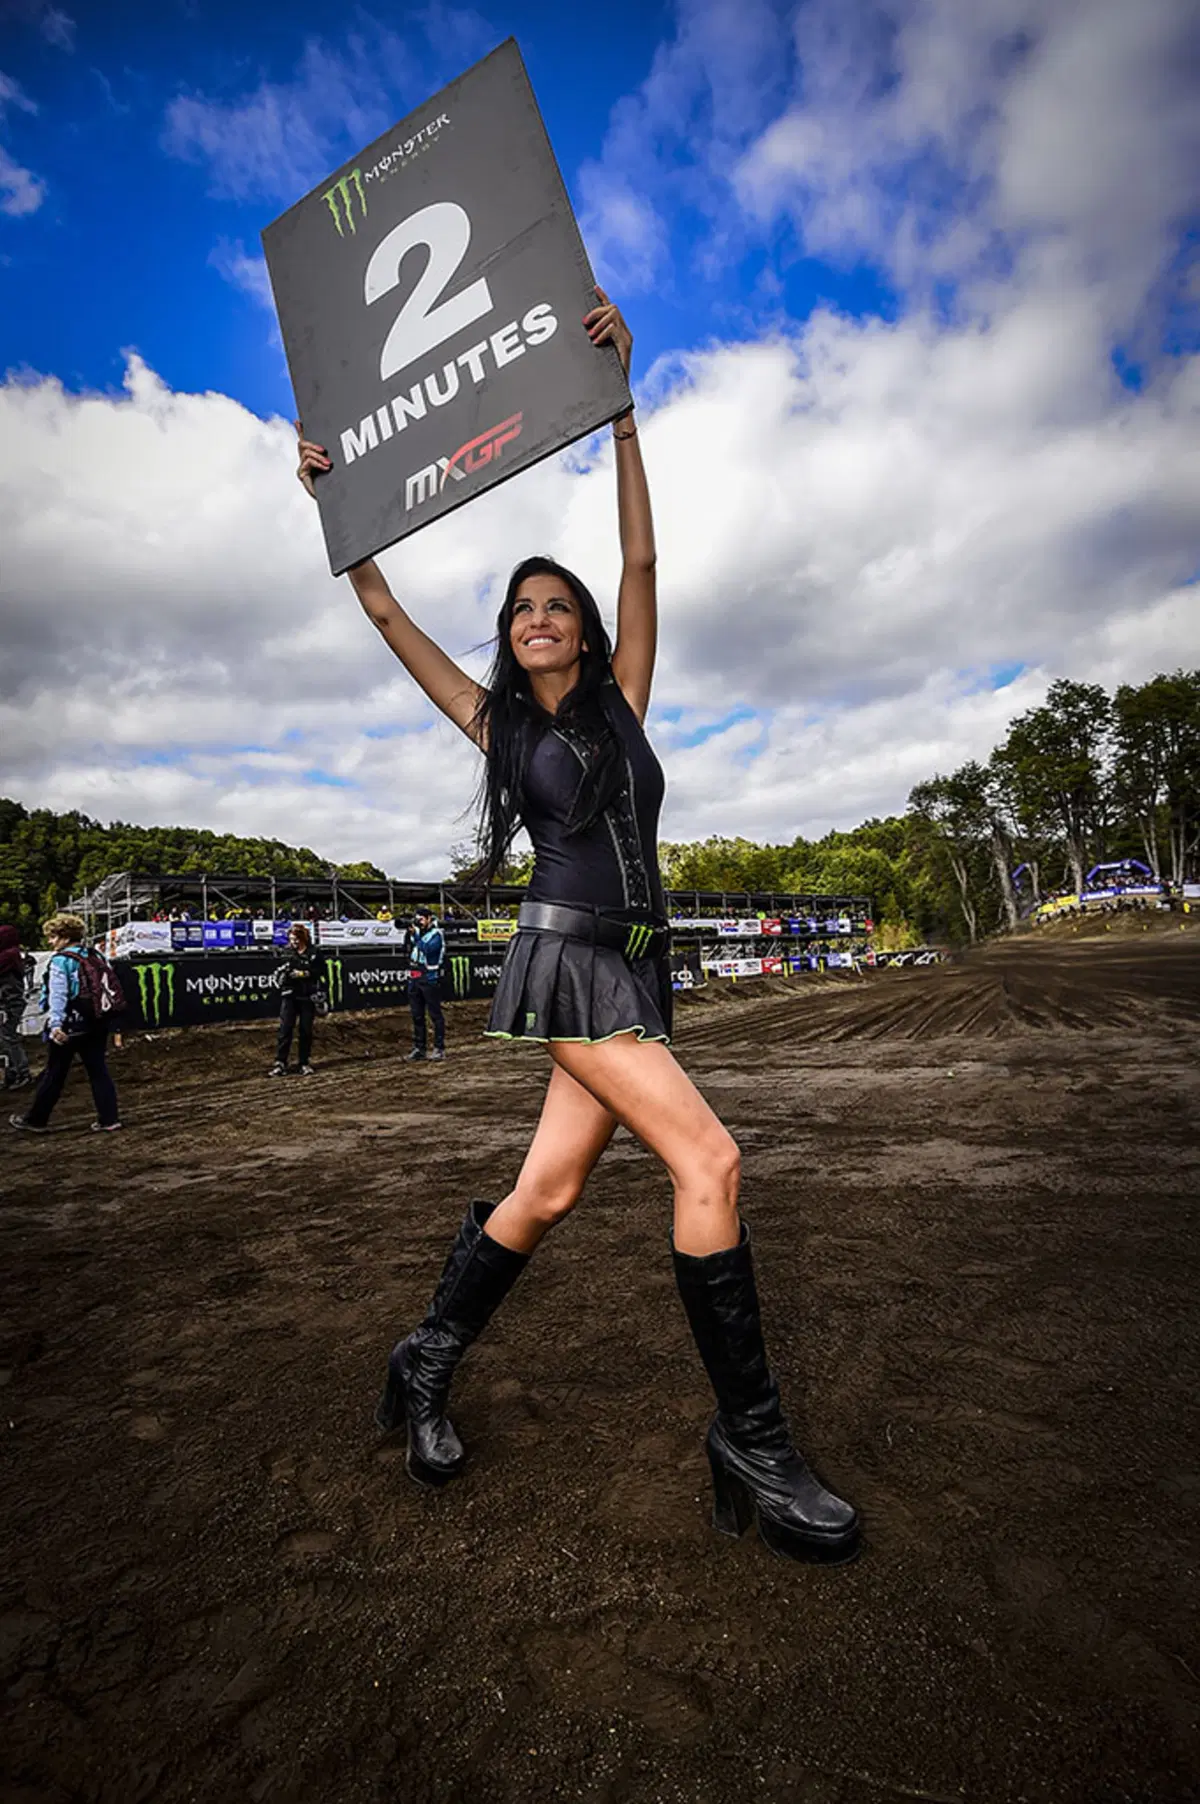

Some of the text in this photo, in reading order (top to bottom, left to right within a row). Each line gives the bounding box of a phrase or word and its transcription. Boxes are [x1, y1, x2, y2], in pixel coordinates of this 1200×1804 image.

[364, 113, 451, 183] MONSTER
[363, 201, 494, 382] 2
[339, 302, 559, 465] MINUTES
[404, 411, 524, 512] MXGP
[186, 973, 280, 994] MONSTER
[202, 993, 269, 1005] ENERGY
